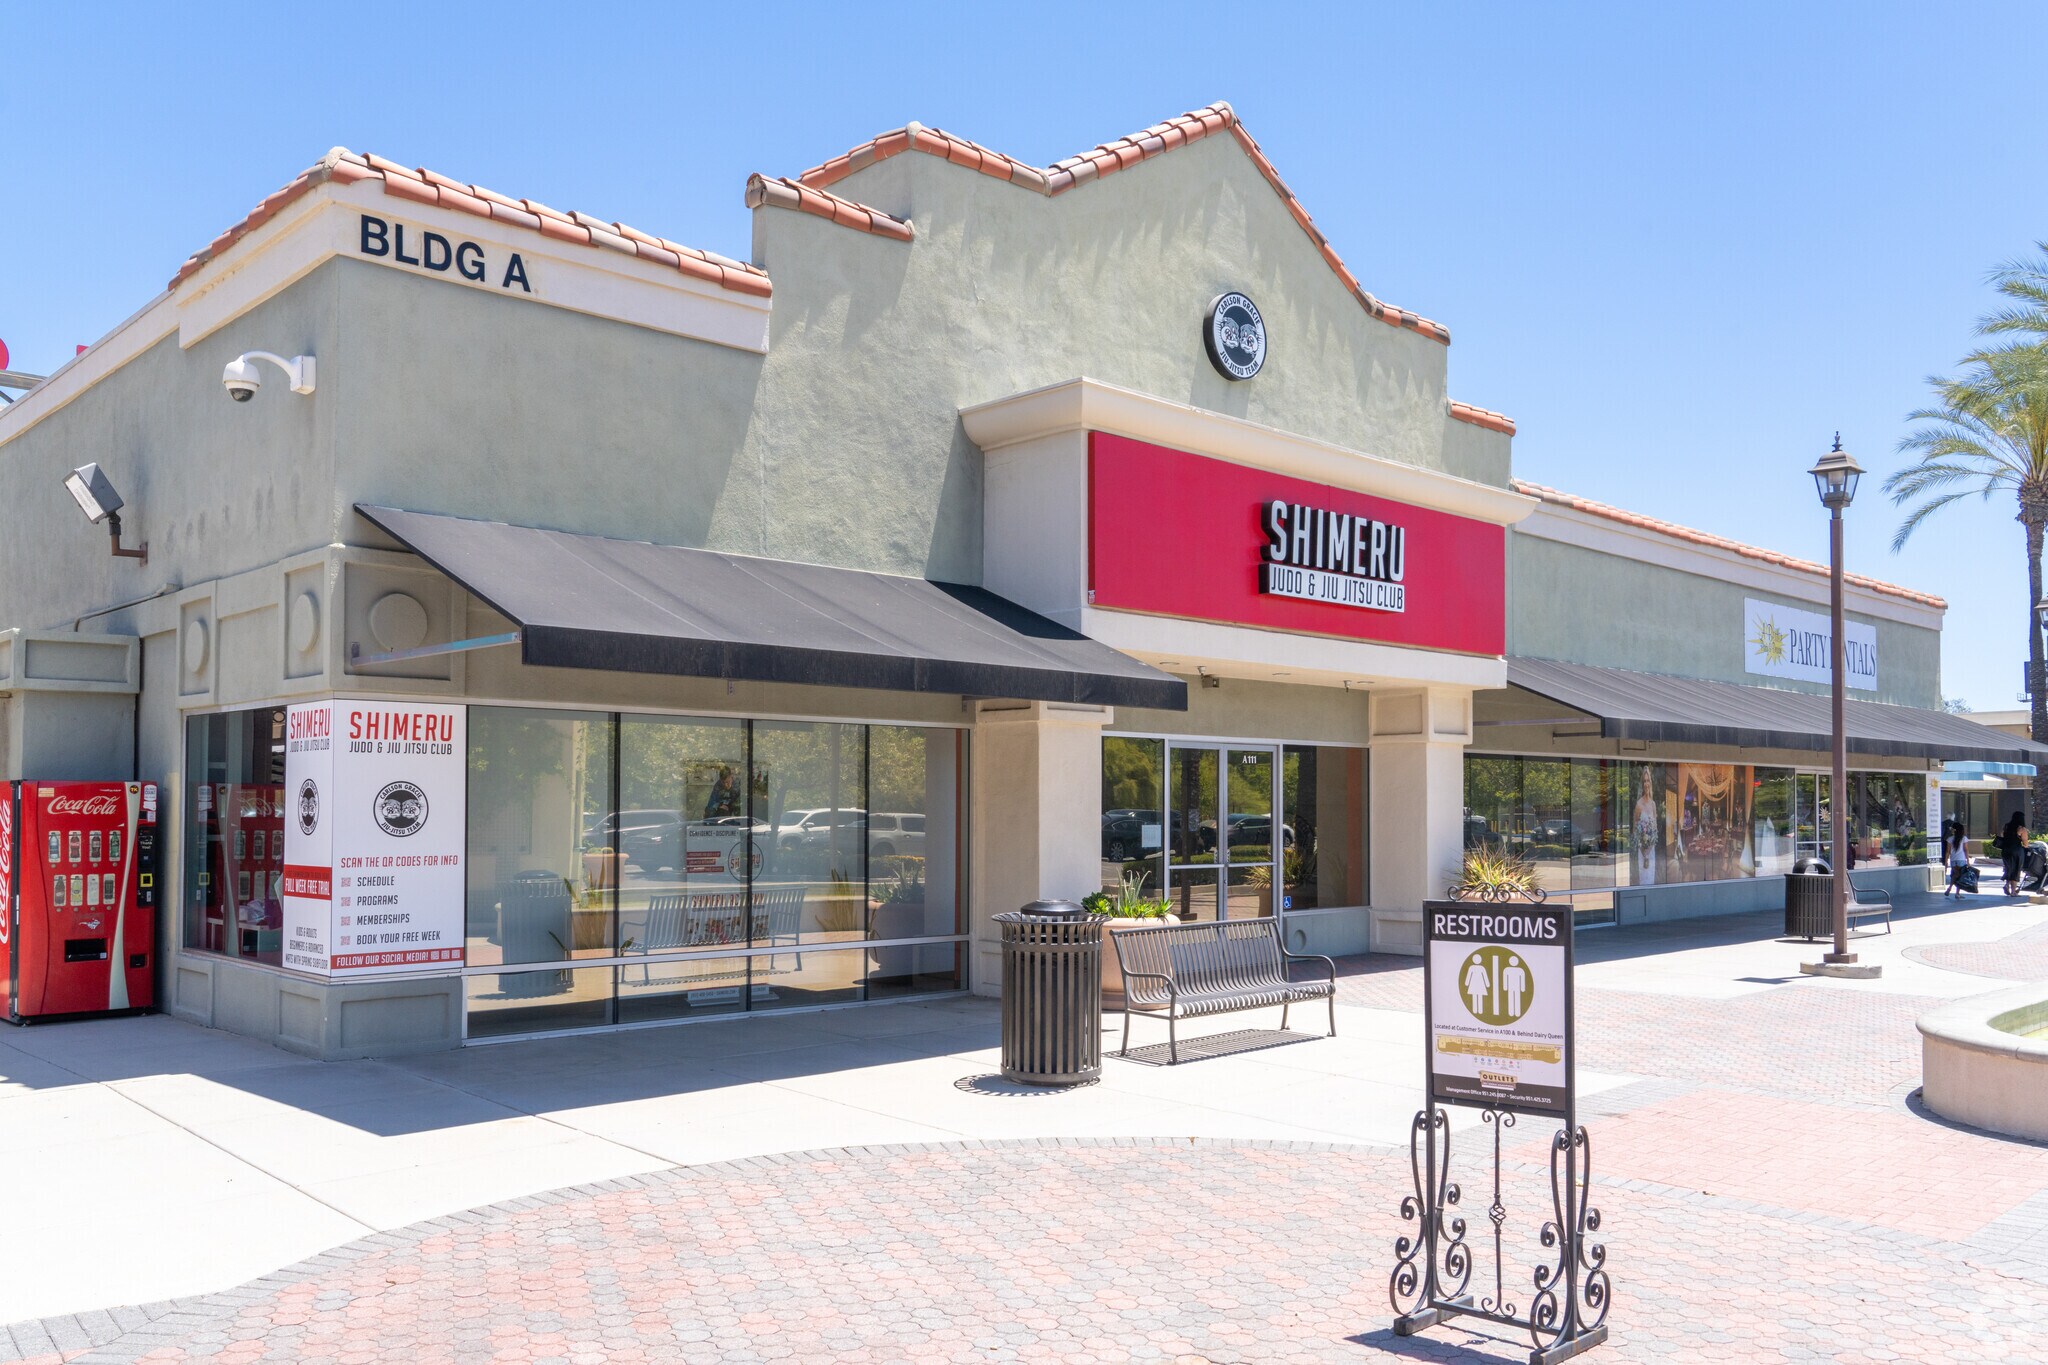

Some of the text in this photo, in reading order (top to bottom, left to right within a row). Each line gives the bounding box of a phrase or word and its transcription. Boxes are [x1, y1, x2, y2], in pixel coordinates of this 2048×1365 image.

[361, 214, 531, 292] BLDG A
[1219, 297, 1260, 325] CARLSON GRACIE
[1220, 351, 1259, 375] JIU-JITSU TEAM
[1270, 500, 1405, 582] SHIMERU
[1271, 567, 1404, 609] JUDO & JIU JITSU CLUB
[1790, 629, 1827, 668] PARTY
[1829, 636, 1876, 677] NTALS
[290, 708, 330, 739] SHIMERU
[349, 711, 453, 742] SHIMERU
[349, 741, 452, 755] JUDO & JIU JITSU CLUB
[1242, 755, 1256, 764] A111
[380, 784, 422, 799] CARLSON GRACIE
[47, 796, 120, 815] Coca-Cola
[381, 821, 421, 834] JIU-JITSU TEAM
[341, 855, 458, 868] SCAN THE QR CODES FOR INFO
[295, 879, 306, 893] WEEK
[307, 880, 317, 894] FREE
[357, 876, 395, 887] SCHEDULE
[357, 895, 398, 906] PROGRAMS
[356, 913, 410, 926] MEMBERSHIPS
[1434, 914, 1557, 939] RESTROOMS
[356, 931, 441, 945] BOOK YOUR FREE WEEK
[336, 951, 428, 967] FOLLOW OUR SOCIAL MEDIA!
[1482, 1074, 1514, 1082] OUTLETS
[1445, 1086, 1470, 1094] Management
